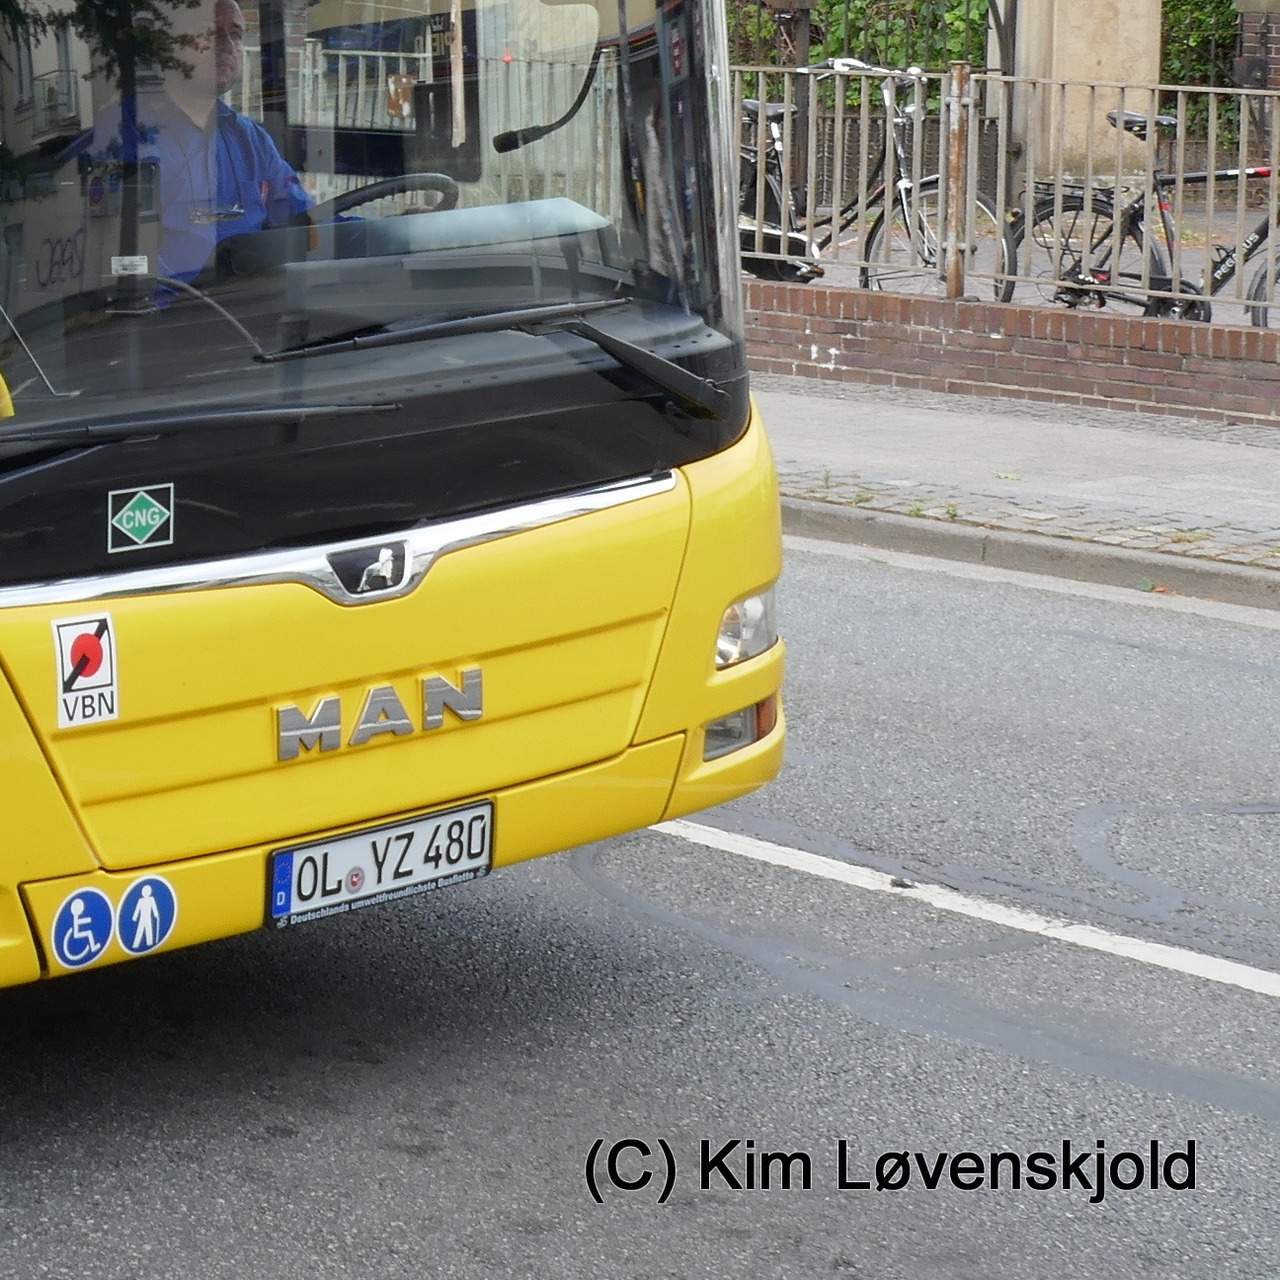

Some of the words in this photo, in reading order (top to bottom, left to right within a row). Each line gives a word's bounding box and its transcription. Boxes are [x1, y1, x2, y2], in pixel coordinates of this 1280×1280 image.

[1213, 232, 1260, 280] PEGUS
[122, 507, 160, 529] CNG
[62, 690, 115, 722] VBN
[275, 667, 483, 762] MAN
[297, 851, 342, 902] OL
[371, 830, 415, 885] YZ
[423, 813, 486, 869] 480
[276, 891, 286, 906] D
[290, 902, 350, 925] Deutschlands
